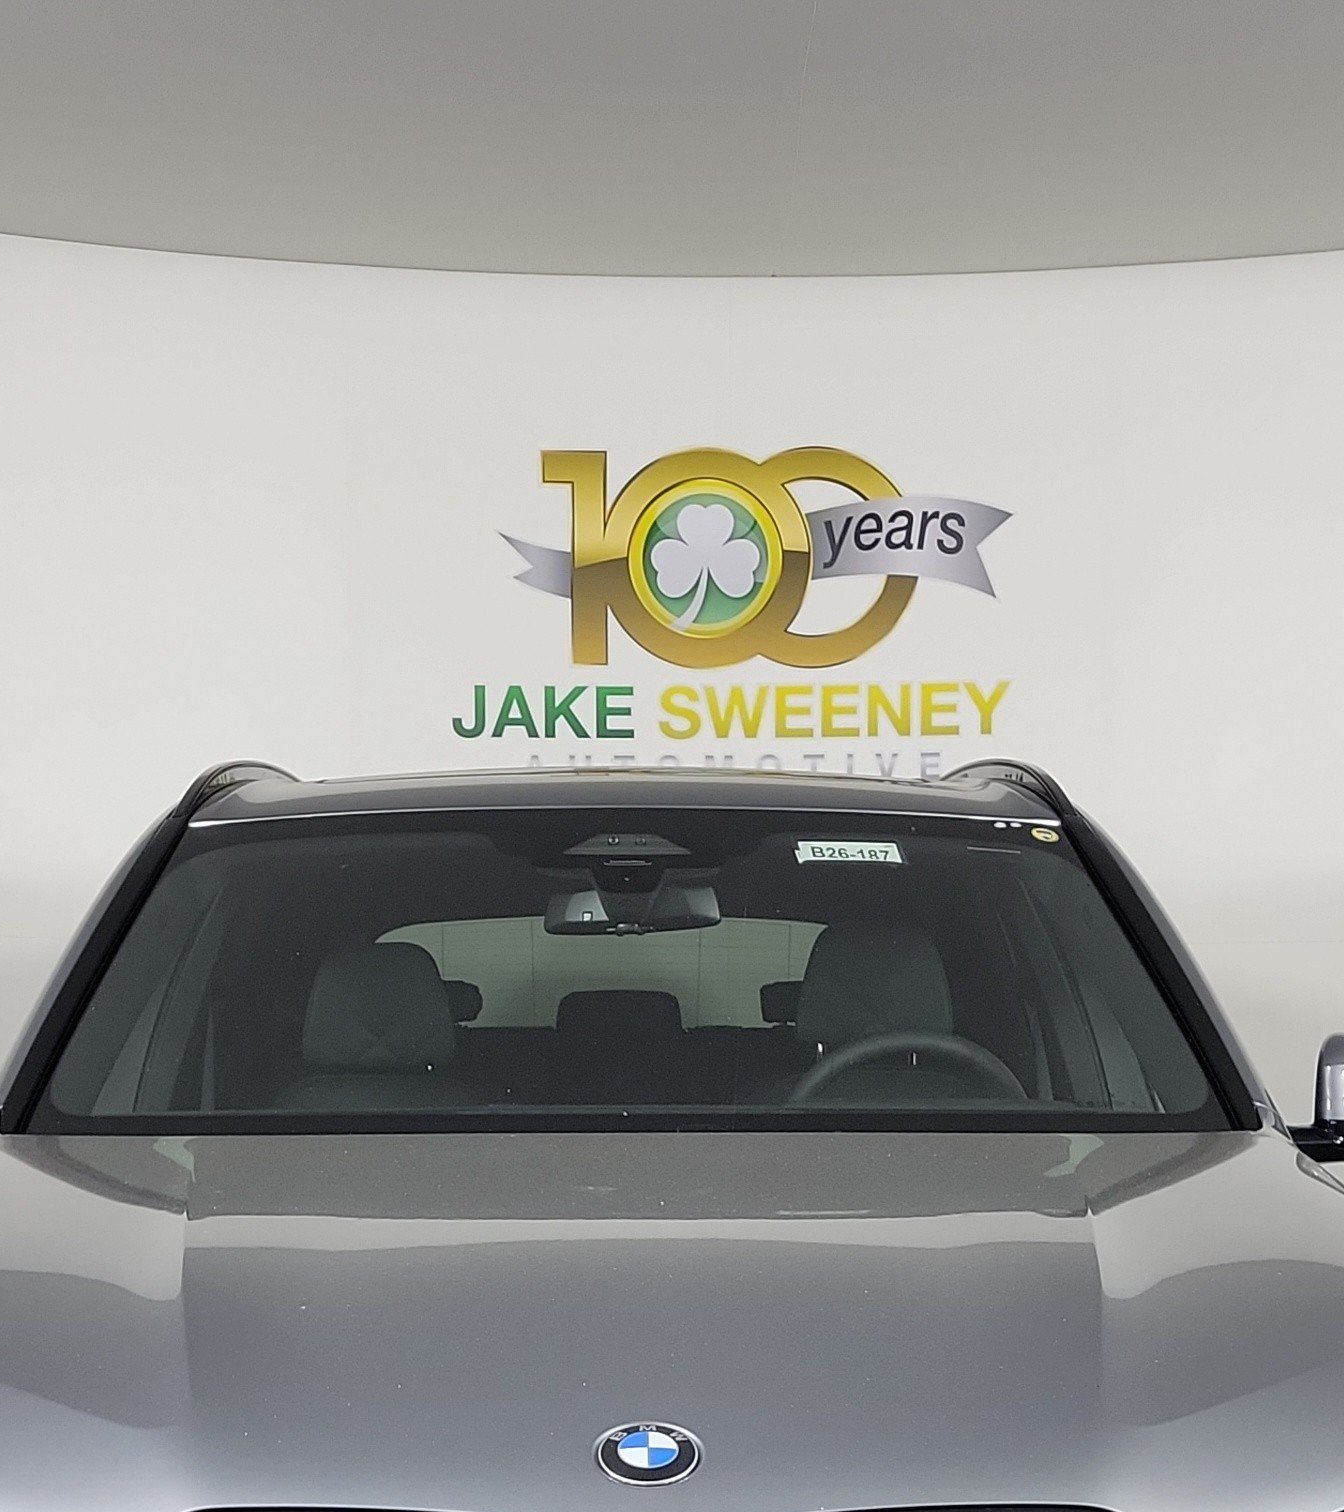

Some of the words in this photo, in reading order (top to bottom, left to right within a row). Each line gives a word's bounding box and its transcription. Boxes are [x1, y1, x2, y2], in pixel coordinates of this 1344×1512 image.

[541, 446, 919, 669] 100
[823, 506, 967, 569] years
[451, 684, 635, 739] JAKE
[658, 680, 1011, 740] SWEENEY
[810, 845, 890, 861] B26-187
[609, 1425, 687, 1442] BMW
